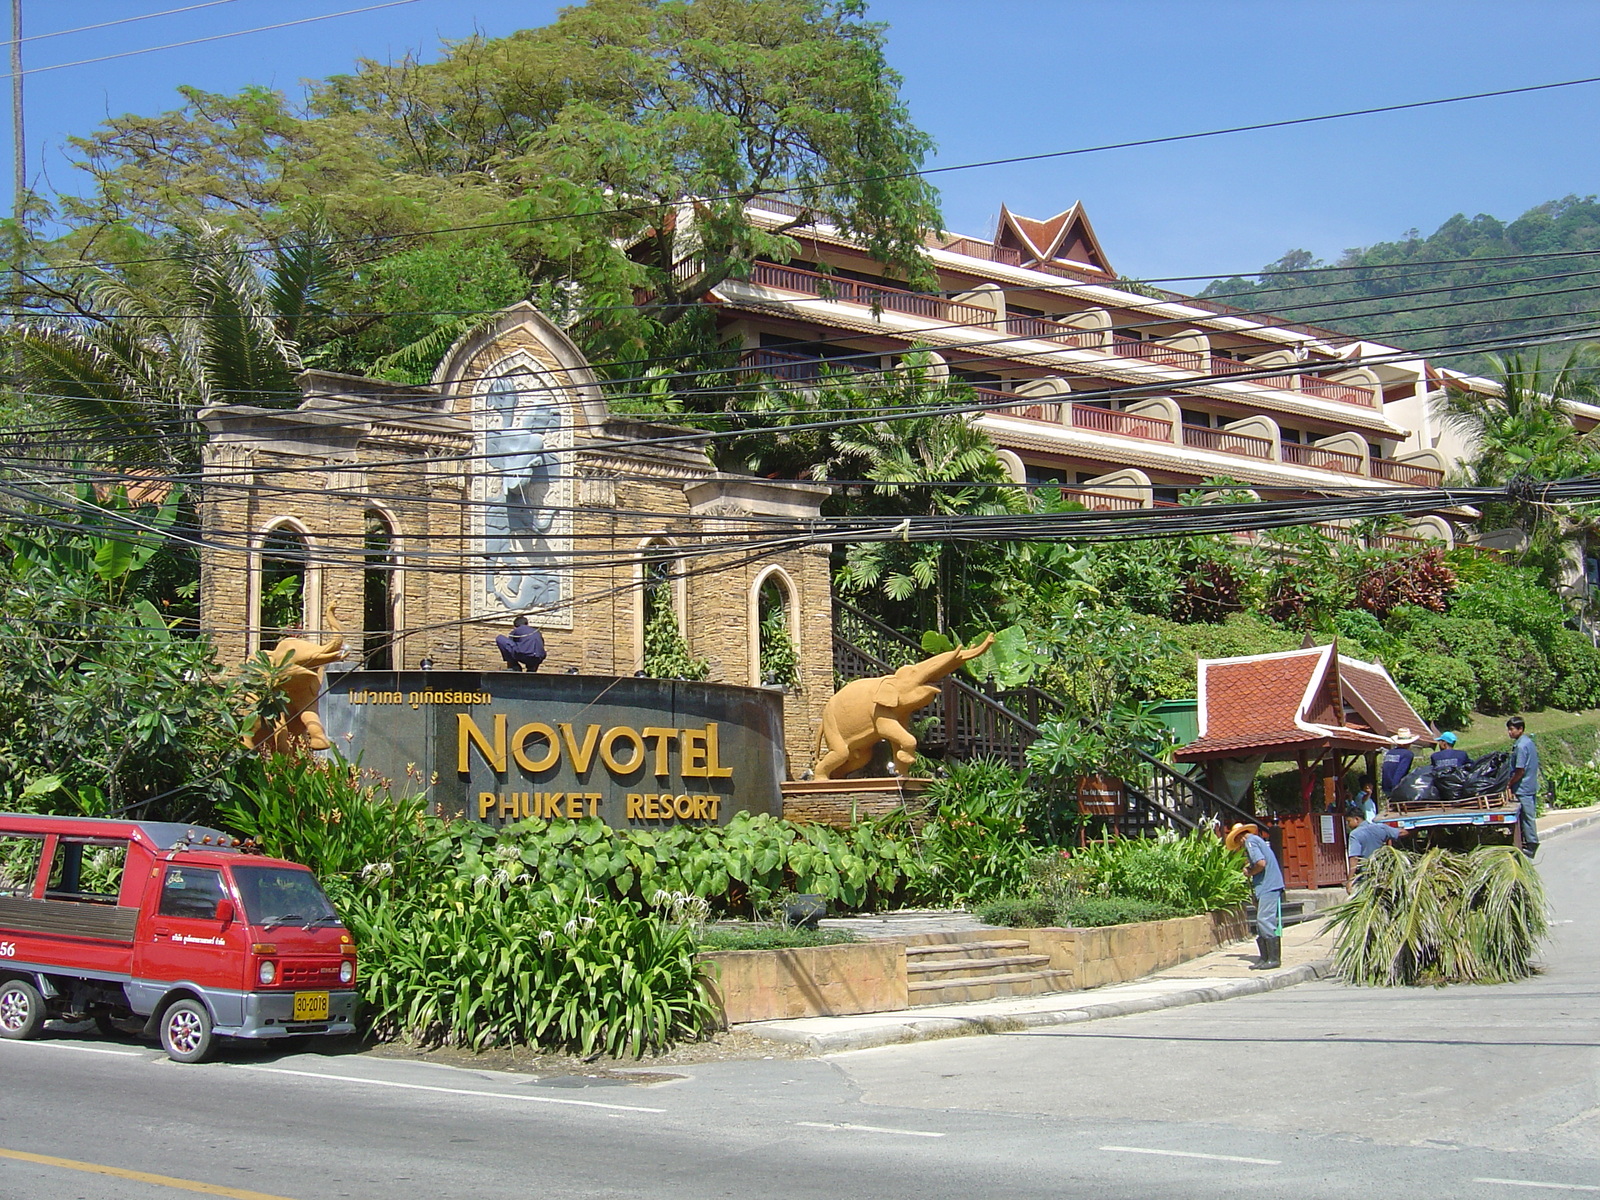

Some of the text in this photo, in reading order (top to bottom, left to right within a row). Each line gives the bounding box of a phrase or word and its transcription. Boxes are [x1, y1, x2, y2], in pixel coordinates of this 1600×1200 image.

[456, 713, 734, 778] NOVOTEL
[478, 791, 721, 821] PHUKET RESORT
